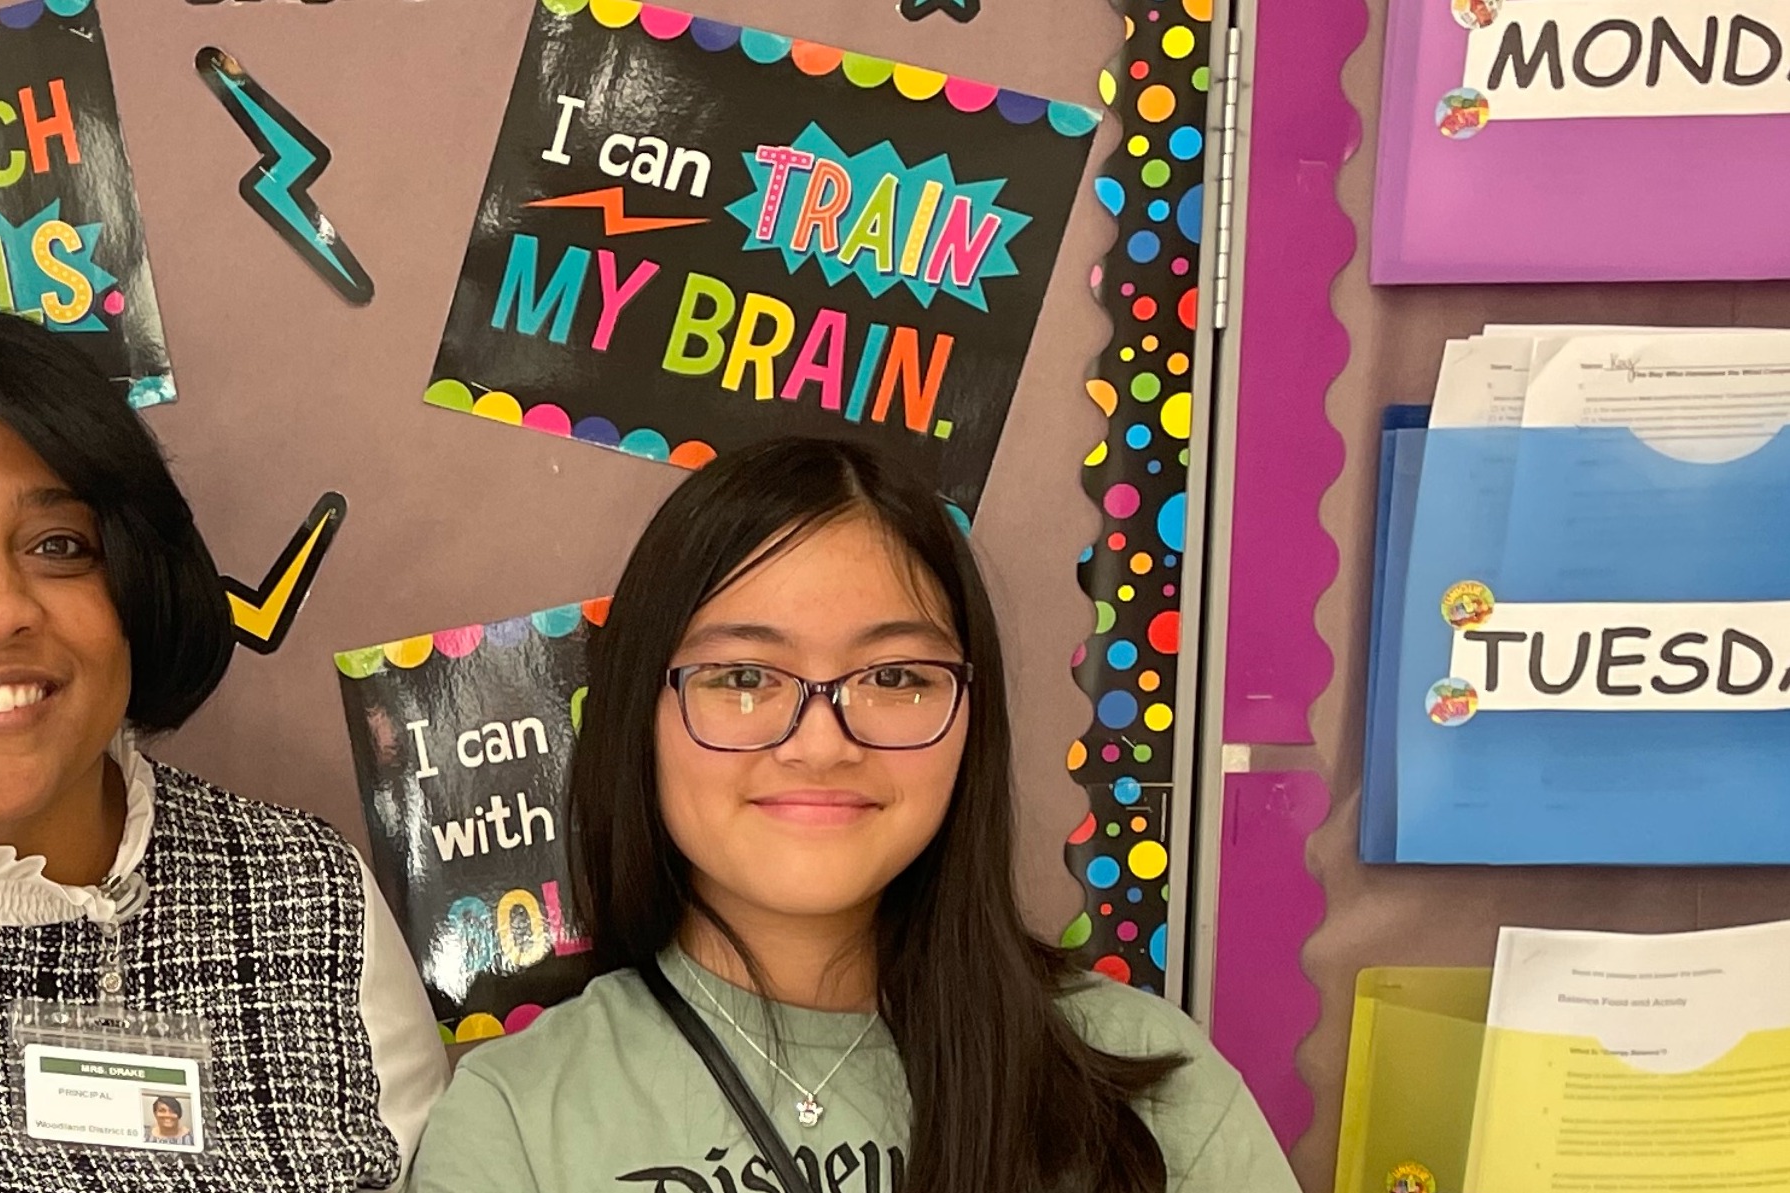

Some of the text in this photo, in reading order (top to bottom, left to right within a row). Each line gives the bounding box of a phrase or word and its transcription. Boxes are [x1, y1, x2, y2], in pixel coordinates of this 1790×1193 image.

[1487, 14, 1790, 90] MOND
[542, 94, 1002, 288] I can TRAIN
[491, 233, 955, 440] MY BRAIN.
[1463, 626, 1790, 696] TUESD
[406, 715, 549, 779] I can
[431, 792, 556, 863] with
[58, 1087, 113, 1101] PRINCIPAL
[109, 1066, 146, 1079] DRAKE
